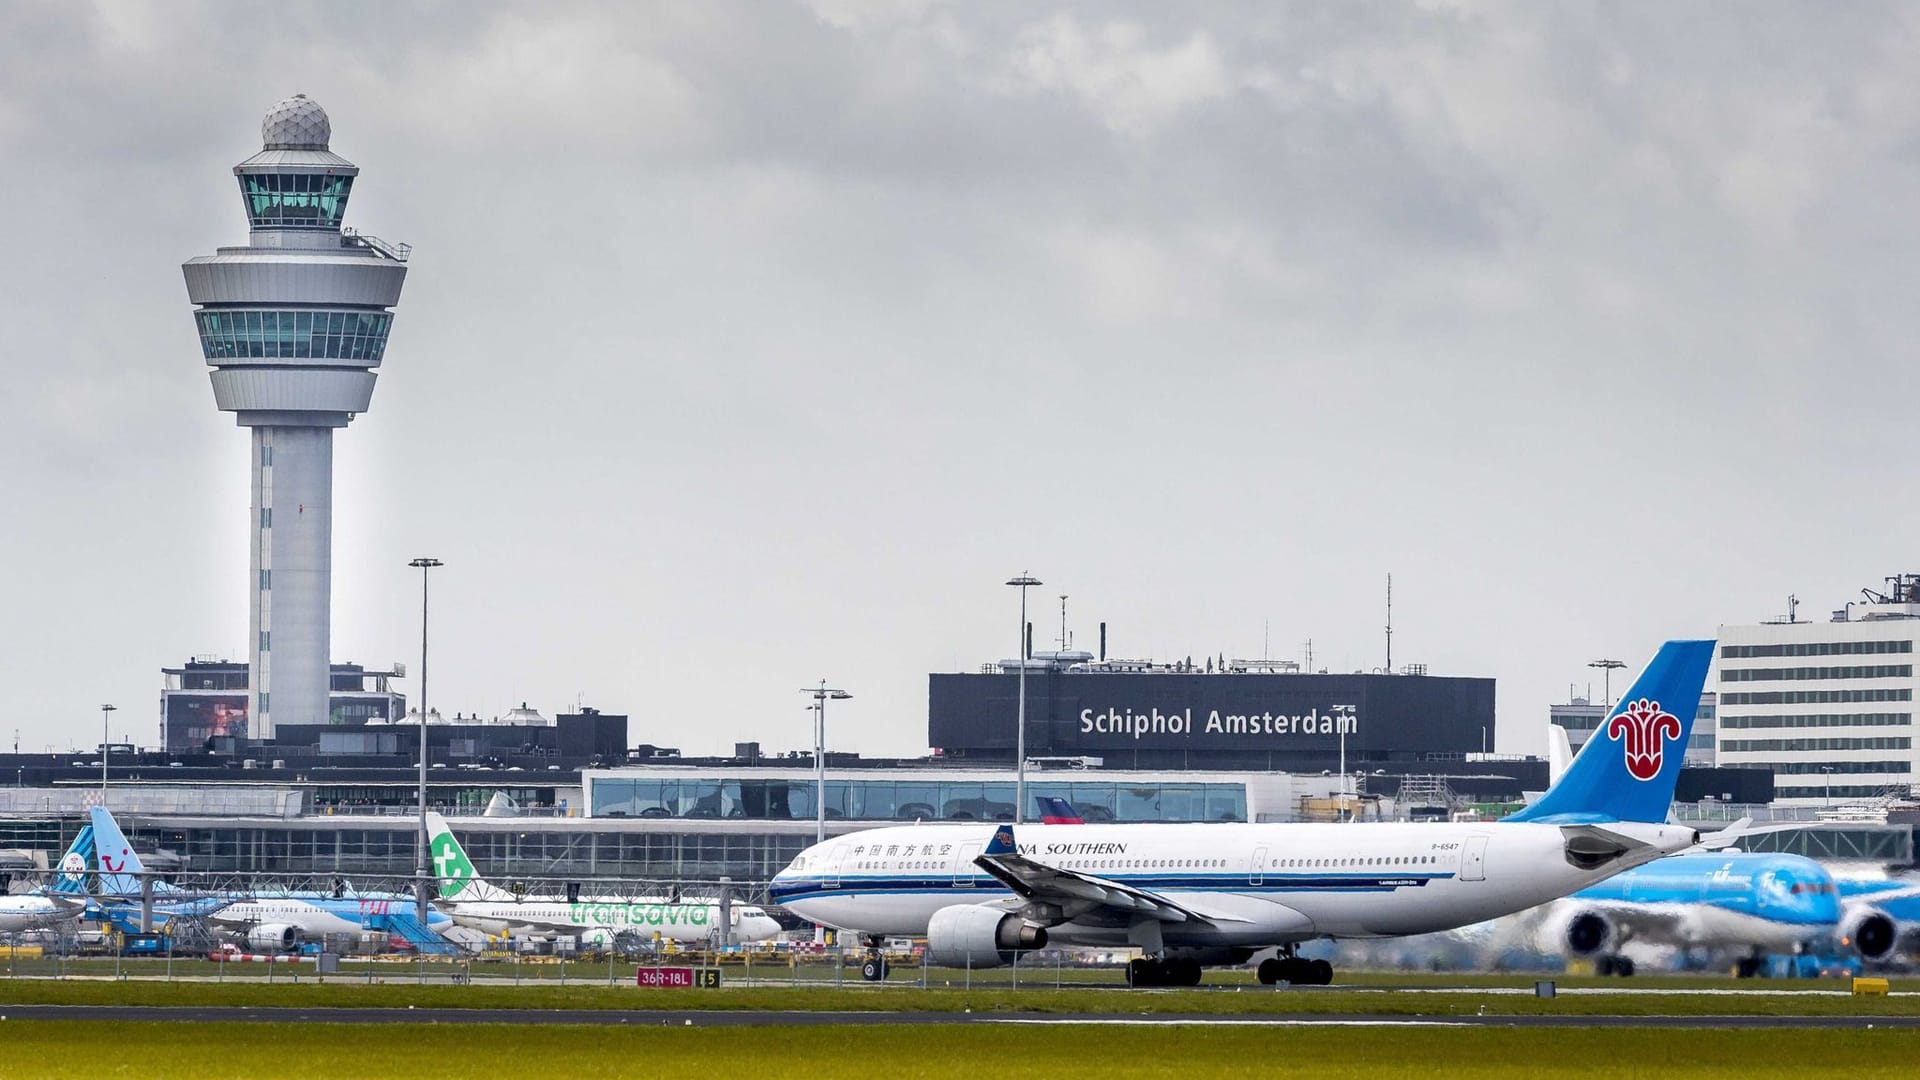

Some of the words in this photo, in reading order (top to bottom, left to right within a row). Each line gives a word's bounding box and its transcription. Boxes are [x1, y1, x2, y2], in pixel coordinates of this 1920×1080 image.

[1080, 707, 1191, 739] Schiphol
[1205, 708, 1358, 734] Amsterdam
[854, 844, 952, 857] 中国南方航空
[1045, 842, 1128, 855] SOUTHERN
[570, 902, 708, 925] transavia
[642, 972, 688, 985] 36R-18L
